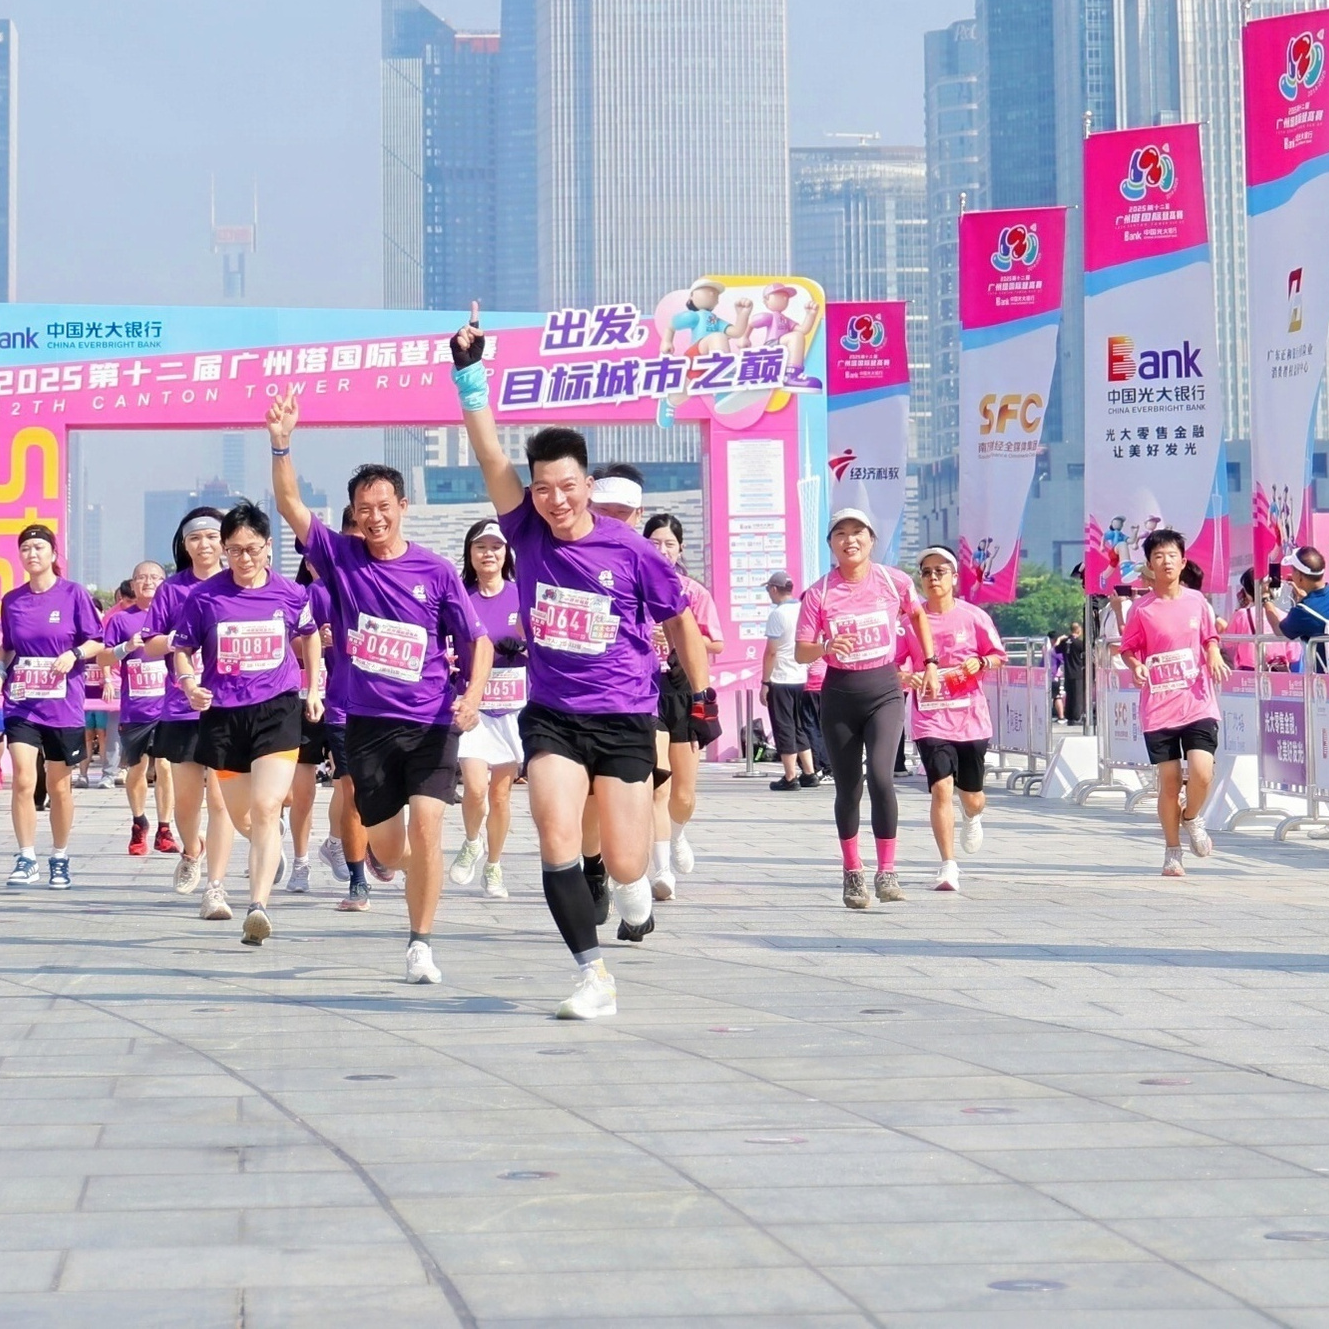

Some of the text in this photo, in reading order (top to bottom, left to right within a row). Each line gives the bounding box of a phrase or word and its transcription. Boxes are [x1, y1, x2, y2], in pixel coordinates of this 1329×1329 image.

[1123, 230, 1142, 242] Bank
[47, 321, 162, 339] 中国光大银行
[47, 341, 162, 349] CHINA EVERBRIGHT BANK
[1107, 335, 1204, 383] Bank
[500, 347, 784, 407] 目标城市之巅
[91, 387, 219, 411] CANTON
[375, 371, 435, 390] RUN
[1107, 384, 1206, 405] 中国光大银行
[978, 392, 1044, 436] SFC
[1108, 403, 1206, 415] CHINA EVERBRIGHT BANK
[1105, 424, 1205, 442] 光大零售金融
[1112, 442, 1198, 459] 让美好发光
[849, 467, 900, 481] 经济科教
[546, 605, 592, 634] 0641
[533, 626, 542, 637] 12
[232, 637, 271, 655] 0081
[366, 635, 412, 661] 0640
[136, 673, 164, 685] 0190
[484, 681, 516, 696] 0651
